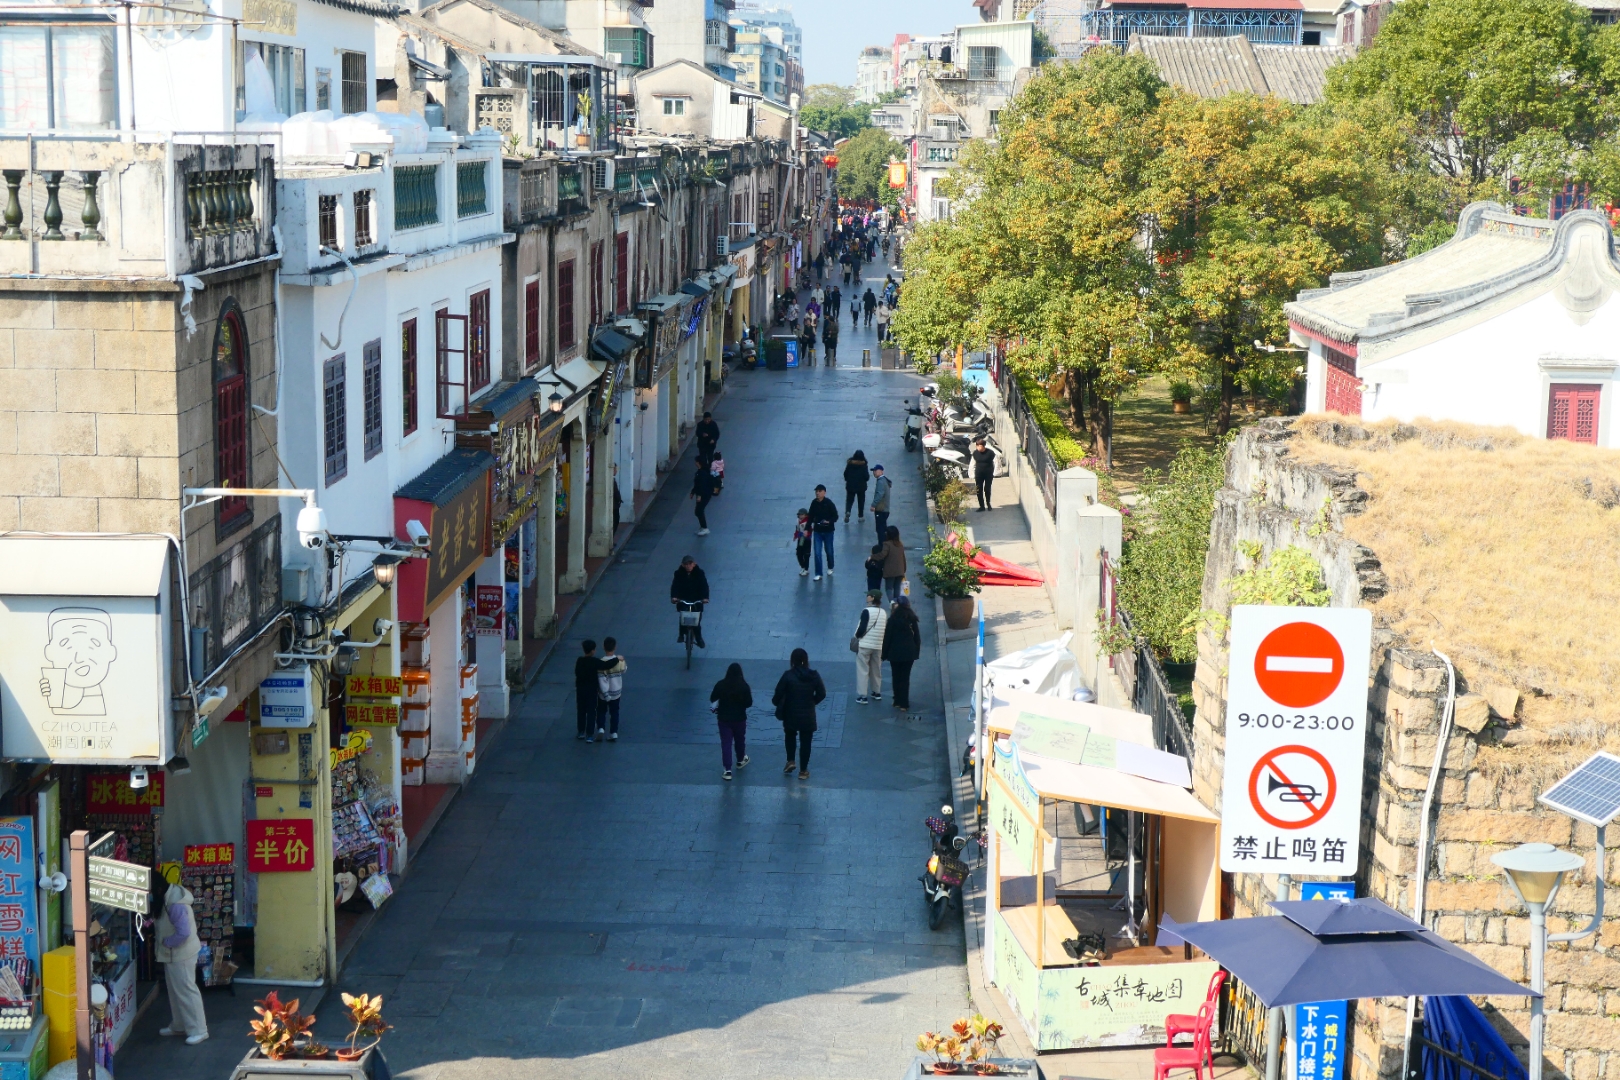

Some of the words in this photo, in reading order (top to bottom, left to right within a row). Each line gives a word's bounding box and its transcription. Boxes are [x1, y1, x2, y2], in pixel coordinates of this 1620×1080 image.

[350, 676, 400, 694] 冰箱贴
[346, 705, 398, 724] 网红雪糕
[1238, 712, 1355, 731] 9:00-23:00
[41, 721, 118, 732] CZHOUTEA
[91, 779, 161, 806] 冰箱贴
[265, 826, 297, 836] 第二支
[187, 846, 232, 863] 冰箱贴
[254, 839, 309, 865] 半价
[1232, 835, 1348, 864] 禁止鸣笛
[1075, 974, 1183, 1012] 古城集章地图
[1298, 1006, 1320, 1080] 下水门接
